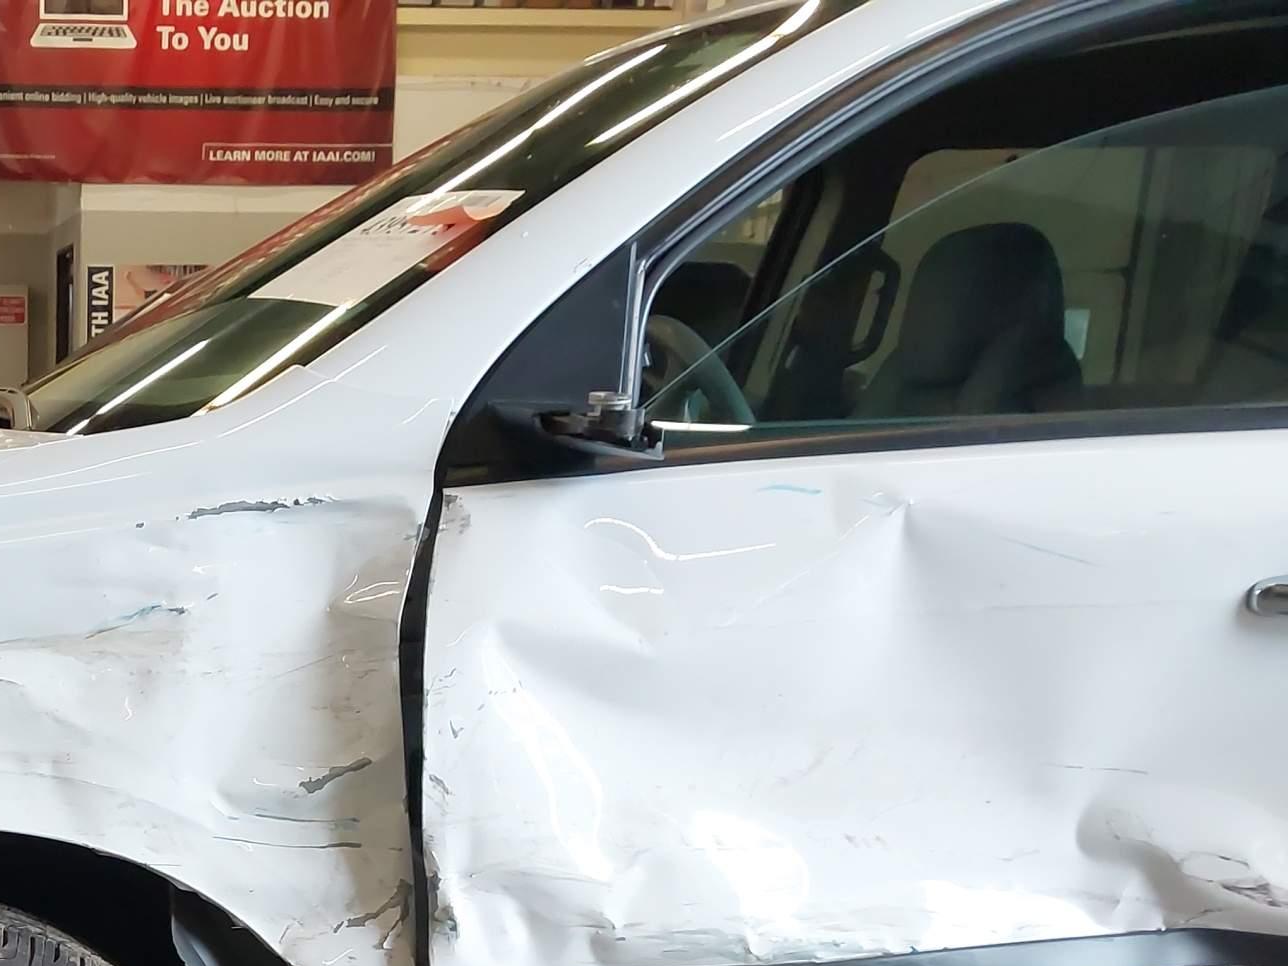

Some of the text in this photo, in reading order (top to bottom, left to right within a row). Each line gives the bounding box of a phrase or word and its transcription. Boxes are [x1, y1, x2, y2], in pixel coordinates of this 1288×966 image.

[162, 0, 330, 18] The Auction
[156, 25, 249, 51] To You
[24, 91, 50, 102] online
[51, 91, 82, 104] bidding
[138, 93, 167, 104] vehicle
[204, 94, 222, 105] Live
[209, 150, 376, 162] LEARN MORE AT IAAI.COM!
[91, 270, 110, 306] IAA
